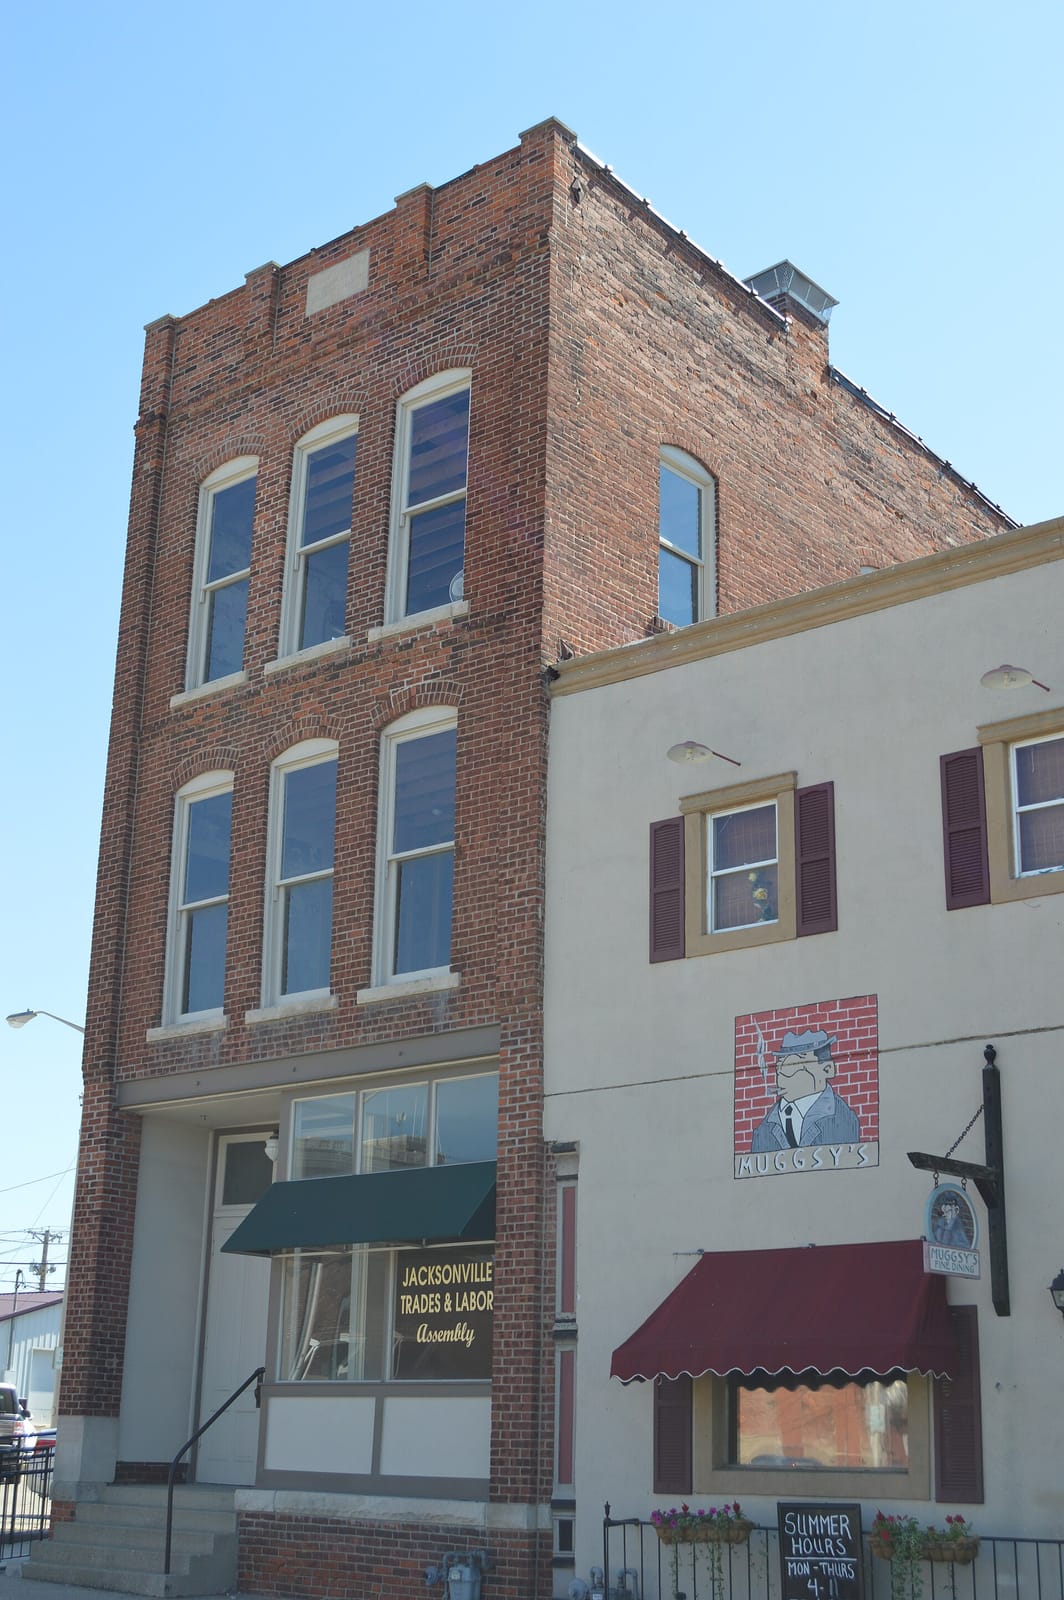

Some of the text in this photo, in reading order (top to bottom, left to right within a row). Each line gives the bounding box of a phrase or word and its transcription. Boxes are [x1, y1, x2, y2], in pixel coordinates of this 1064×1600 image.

[739, 1144, 868, 1176] MUGGSY'S
[931, 1247, 978, 1266] MUGGSY'S
[934, 1260, 975, 1274] FINE DINING
[402, 1261, 493, 1287] JACKSONVILLE
[400, 1290, 494, 1314] TRADES & LABOR
[416, 1321, 475, 1348] Assembly
[784, 1512, 852, 1540] SUMMER
[791, 1537, 846, 1556] HOURS
